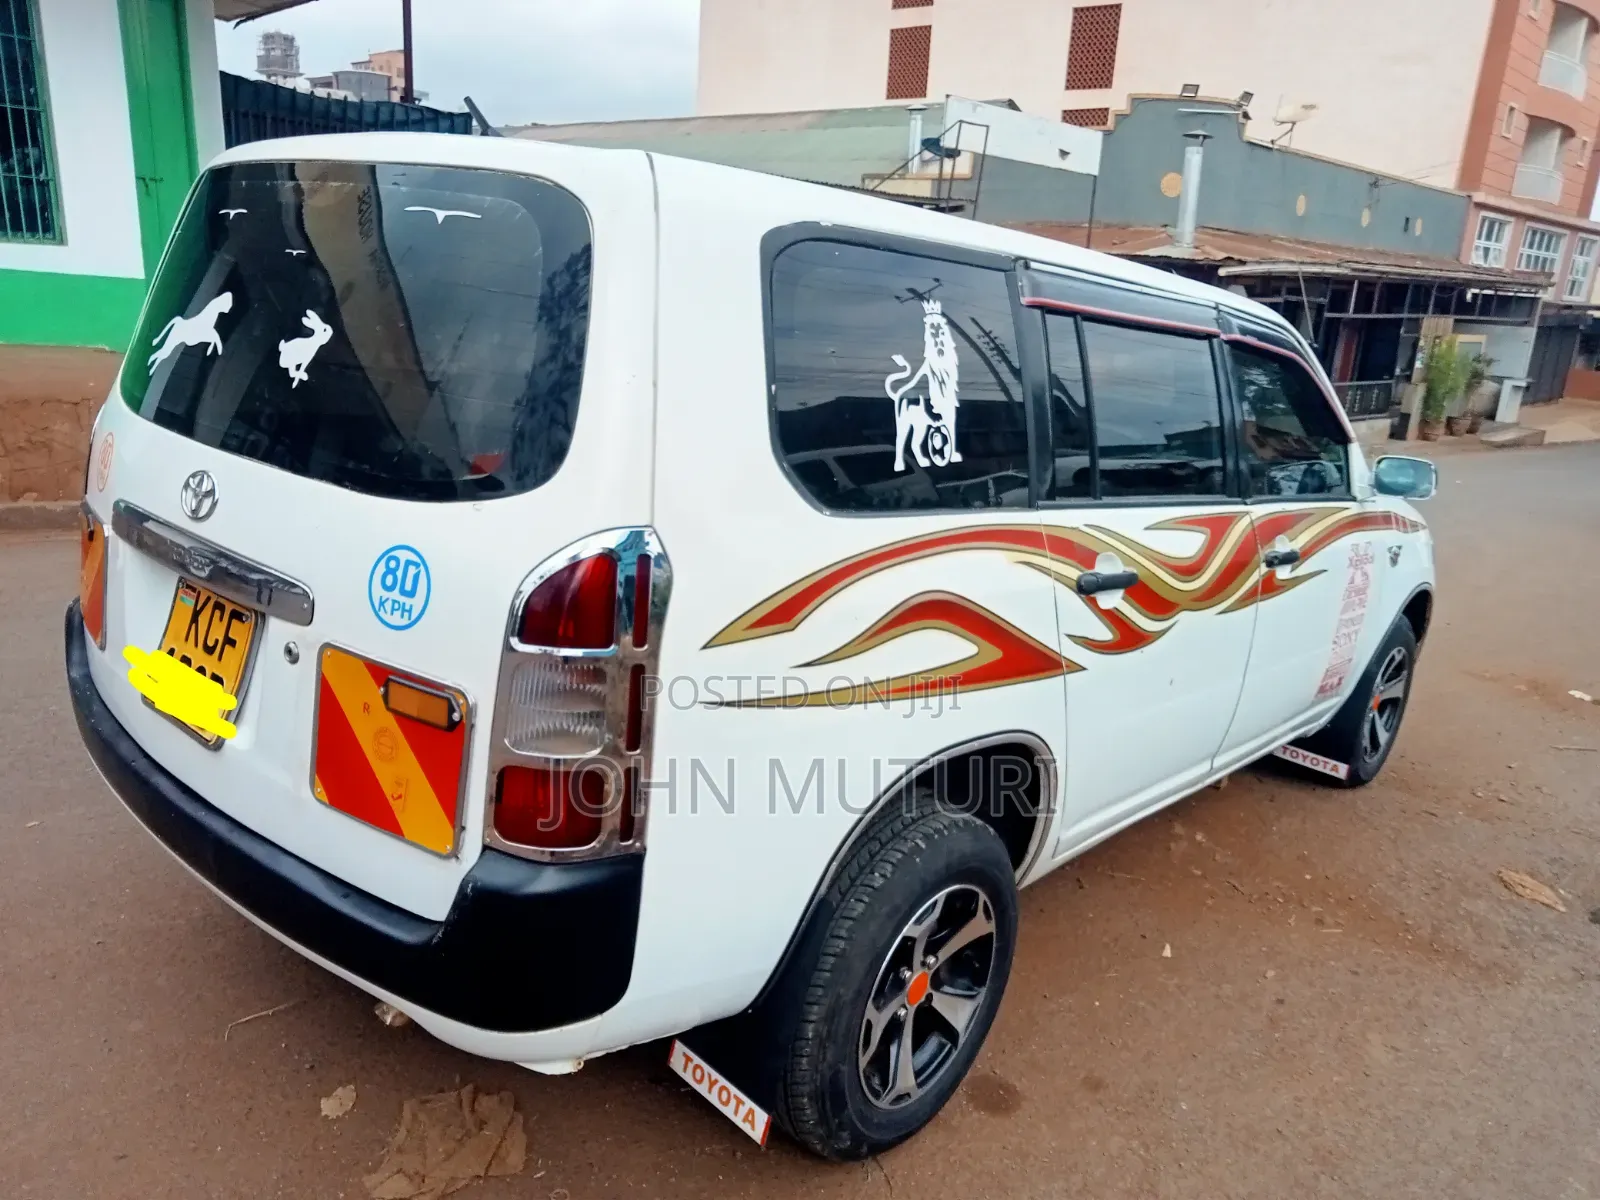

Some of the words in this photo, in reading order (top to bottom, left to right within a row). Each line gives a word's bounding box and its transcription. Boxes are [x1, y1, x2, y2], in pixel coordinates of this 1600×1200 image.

[381, 555, 421, 598] 80
[185, 590, 247, 662] KCF
[378, 596, 413, 621] KPH
[1281, 745, 1340, 774] TOYOTA
[681, 1051, 757, 1132] TOYOTA
